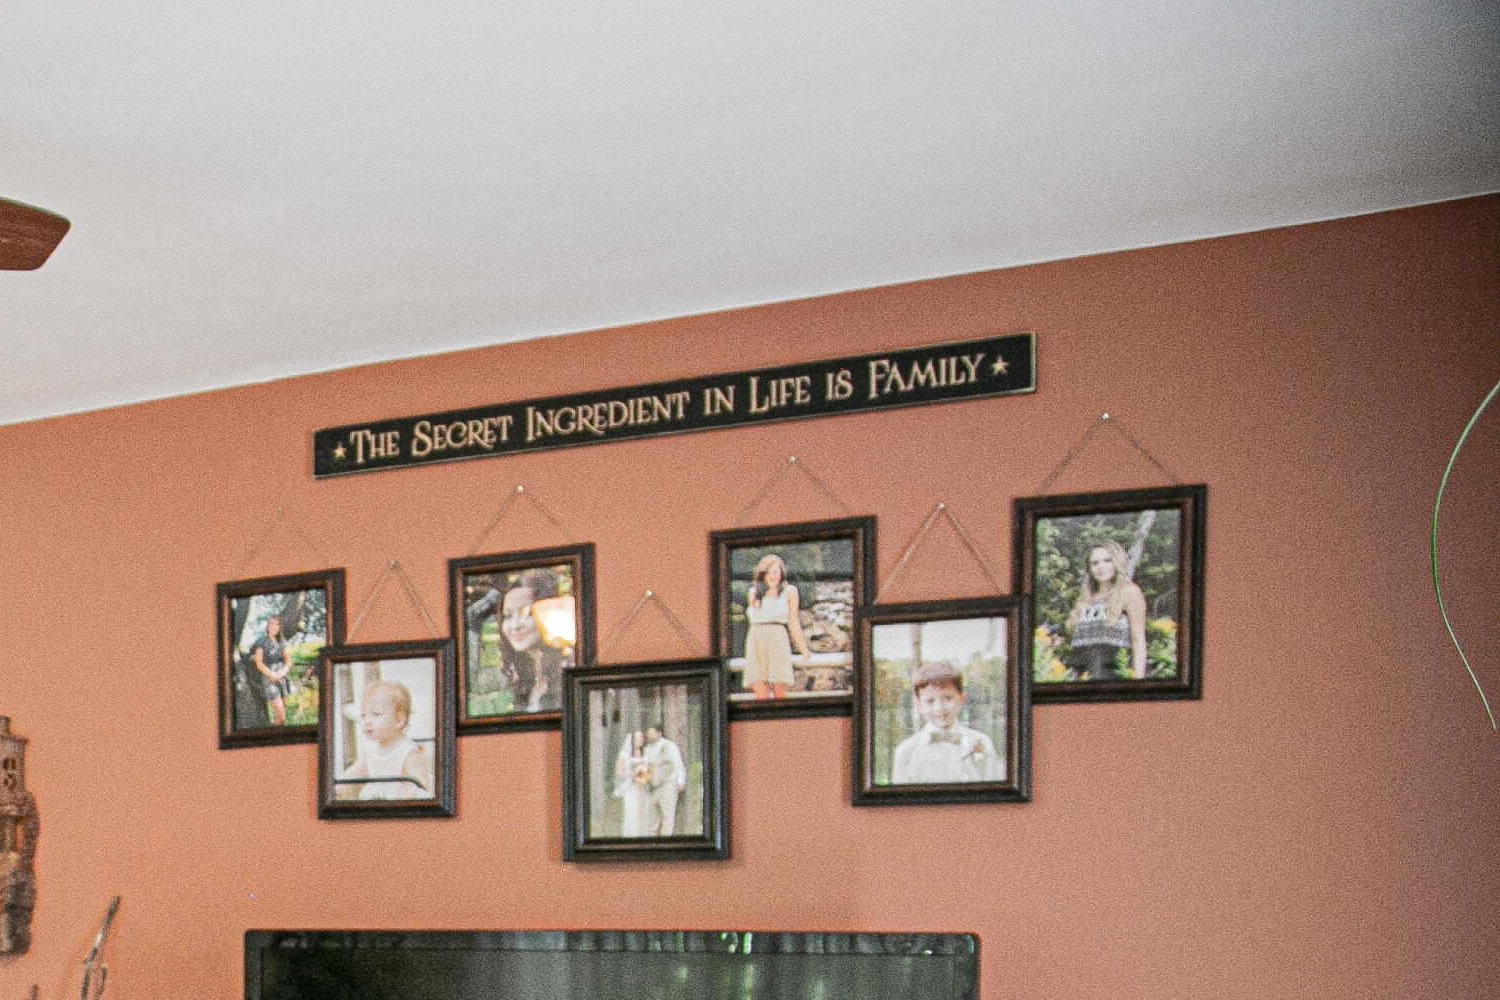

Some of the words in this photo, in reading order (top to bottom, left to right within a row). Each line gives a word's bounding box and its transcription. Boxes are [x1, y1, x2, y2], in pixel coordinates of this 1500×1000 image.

[350, 429, 400, 464] THE
[411, 415, 513, 458] SECRET
[526, 391, 690, 442] INGREDIENT
[704, 385, 736, 416] IN
[750, 375, 811, 413] LIFE
[825, 369, 854, 401] IS
[868, 352, 985, 399] FAMILY
